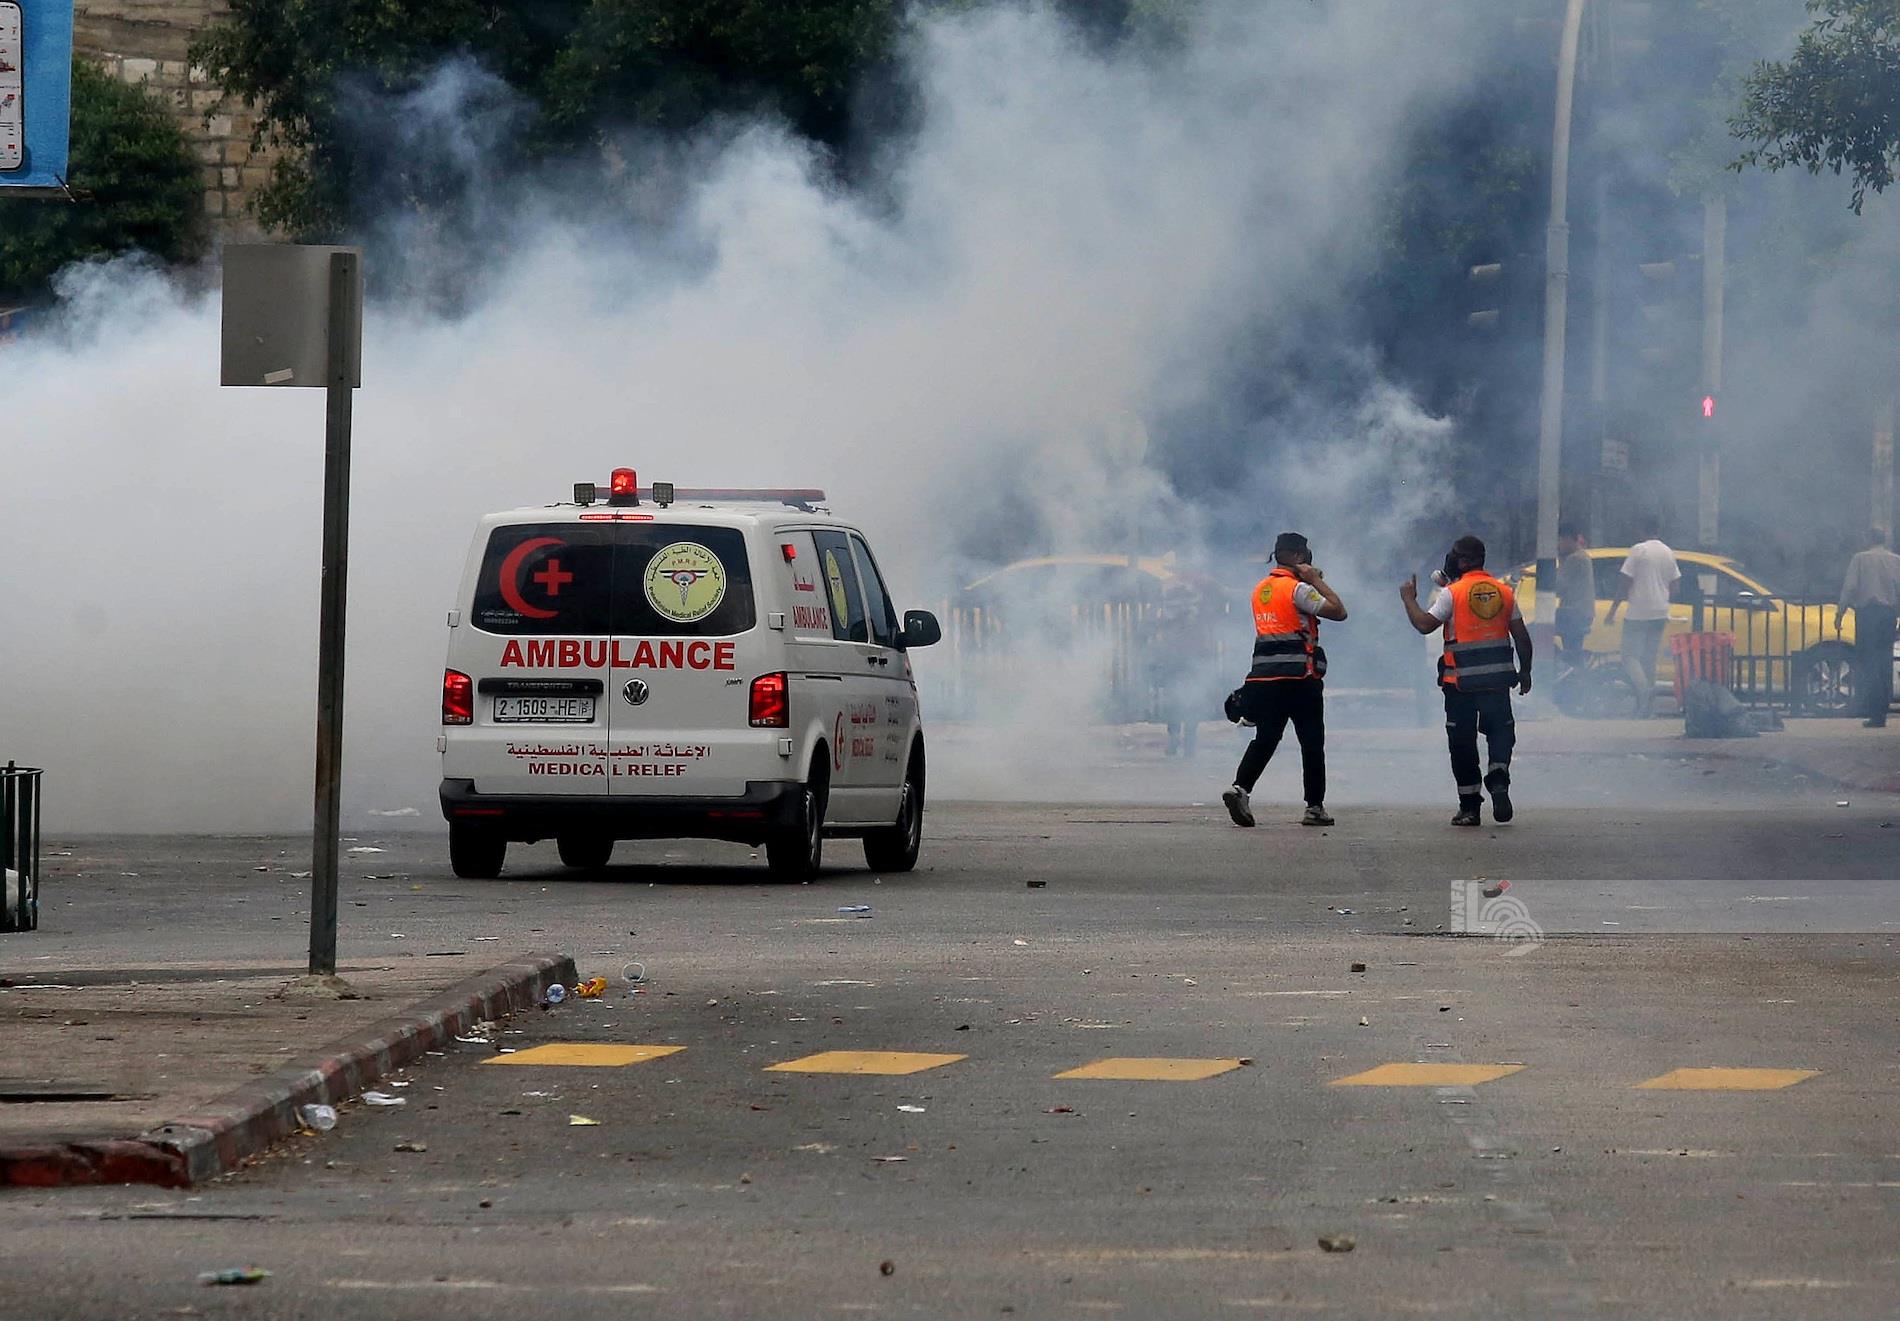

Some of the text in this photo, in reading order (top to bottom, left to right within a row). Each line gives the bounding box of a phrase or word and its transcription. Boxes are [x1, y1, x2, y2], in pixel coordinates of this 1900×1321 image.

[672, 609, 692, 618] Medical
[692, 603, 709, 617] Relief
[707, 586, 722, 607] Society
[792, 605, 828, 630] AMBULANCE
[500, 640, 735, 671] AMBULANCE
[506, 743, 584, 759] الفلسطينية
[628, 764, 687, 776] RELEF
